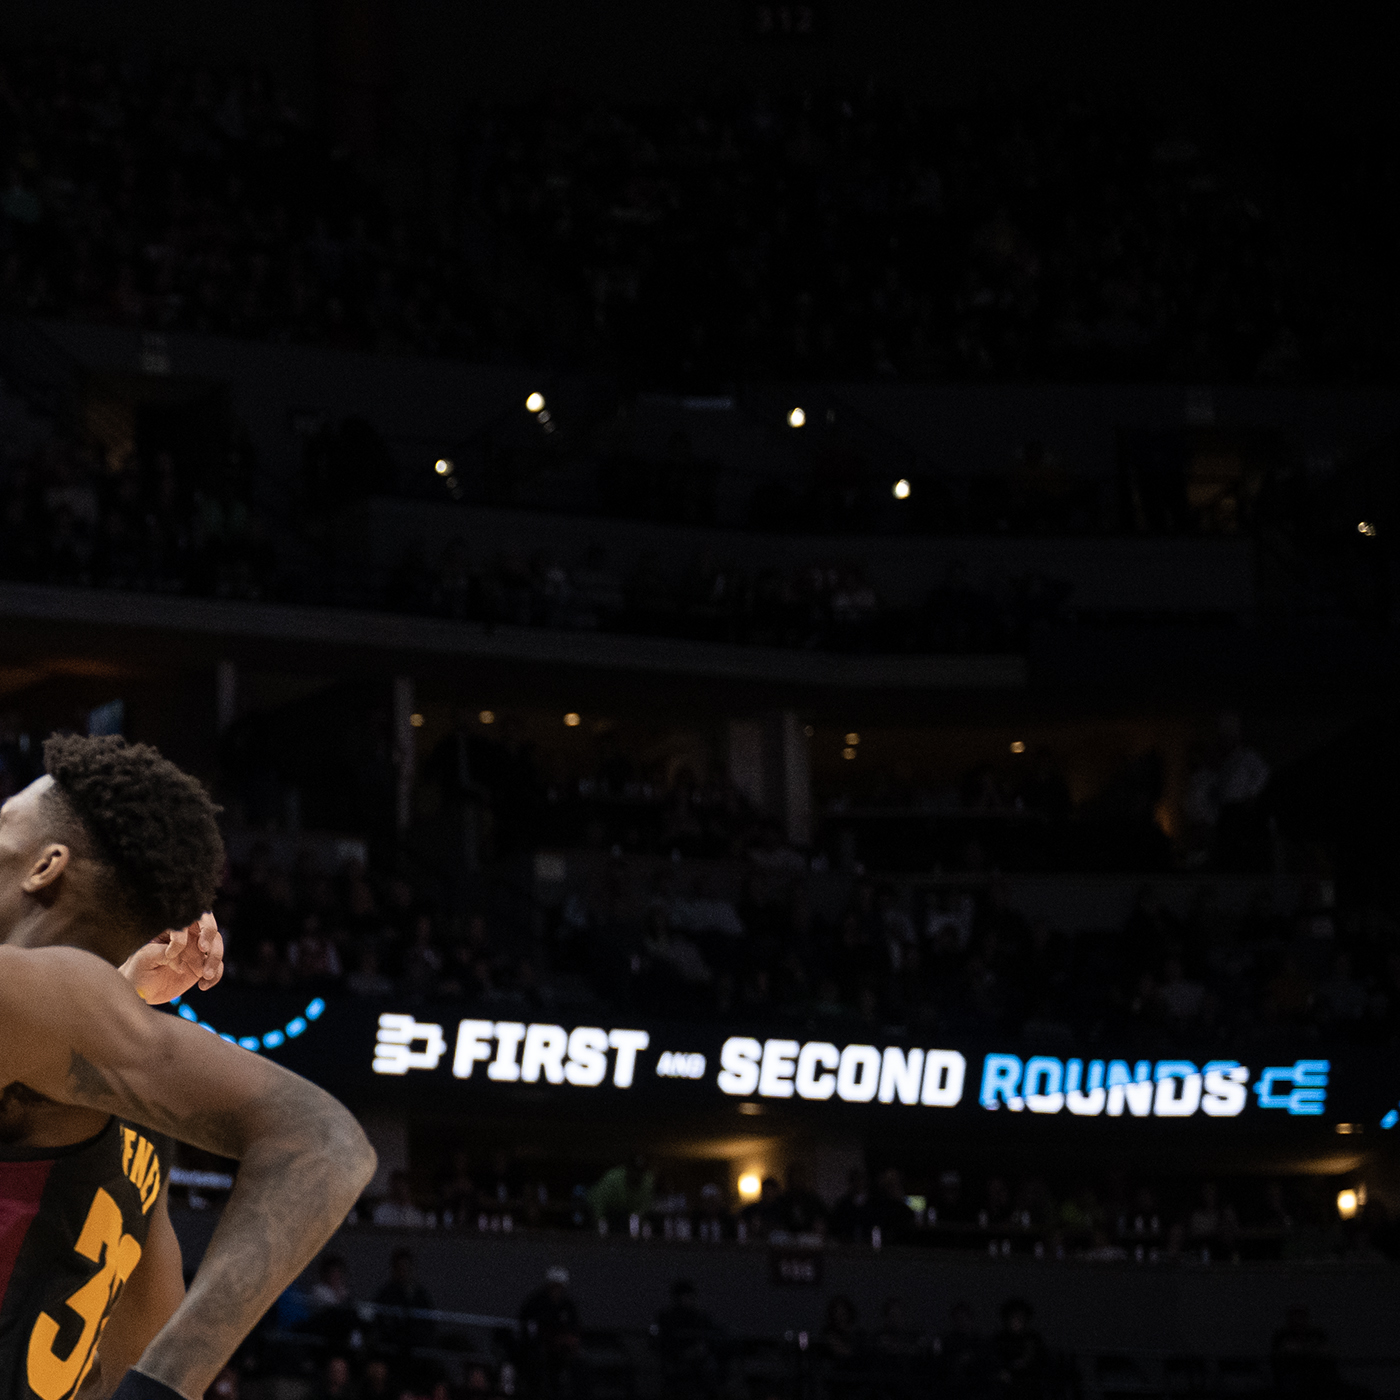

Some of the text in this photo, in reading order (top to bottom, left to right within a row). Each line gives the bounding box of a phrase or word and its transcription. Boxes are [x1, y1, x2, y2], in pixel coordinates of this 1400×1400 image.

[452, 1019, 1248, 1117] FIRST AND SECOND ROUNDS
